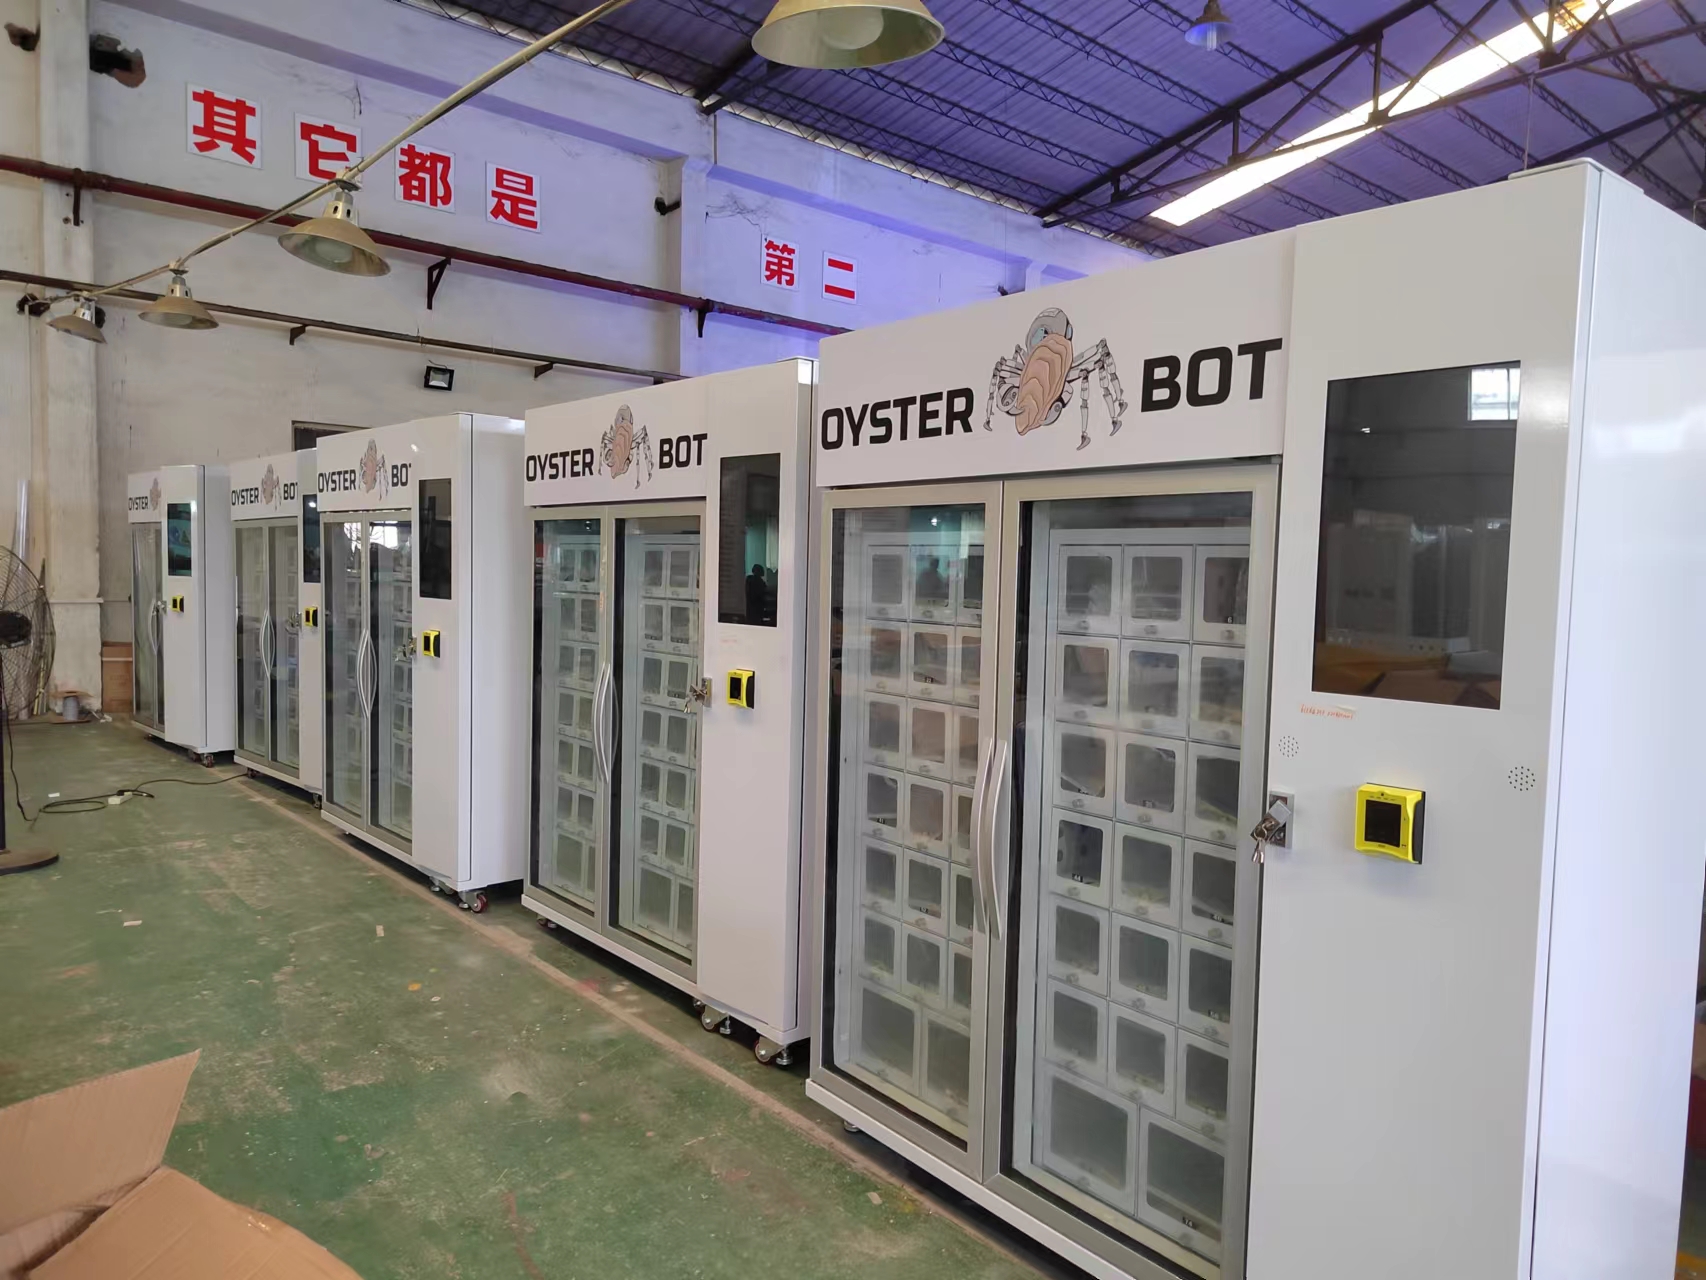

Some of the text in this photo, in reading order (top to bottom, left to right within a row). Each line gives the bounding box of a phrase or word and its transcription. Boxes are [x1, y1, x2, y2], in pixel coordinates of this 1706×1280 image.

[821, 337, 1283, 450] OYSTER BOT
[526, 433, 708, 482] OYSTER BOT
[317, 463, 412, 493] OYSTER BO
[128, 496, 149, 511] OYSTER
[231, 487, 260, 506] OYSTER
